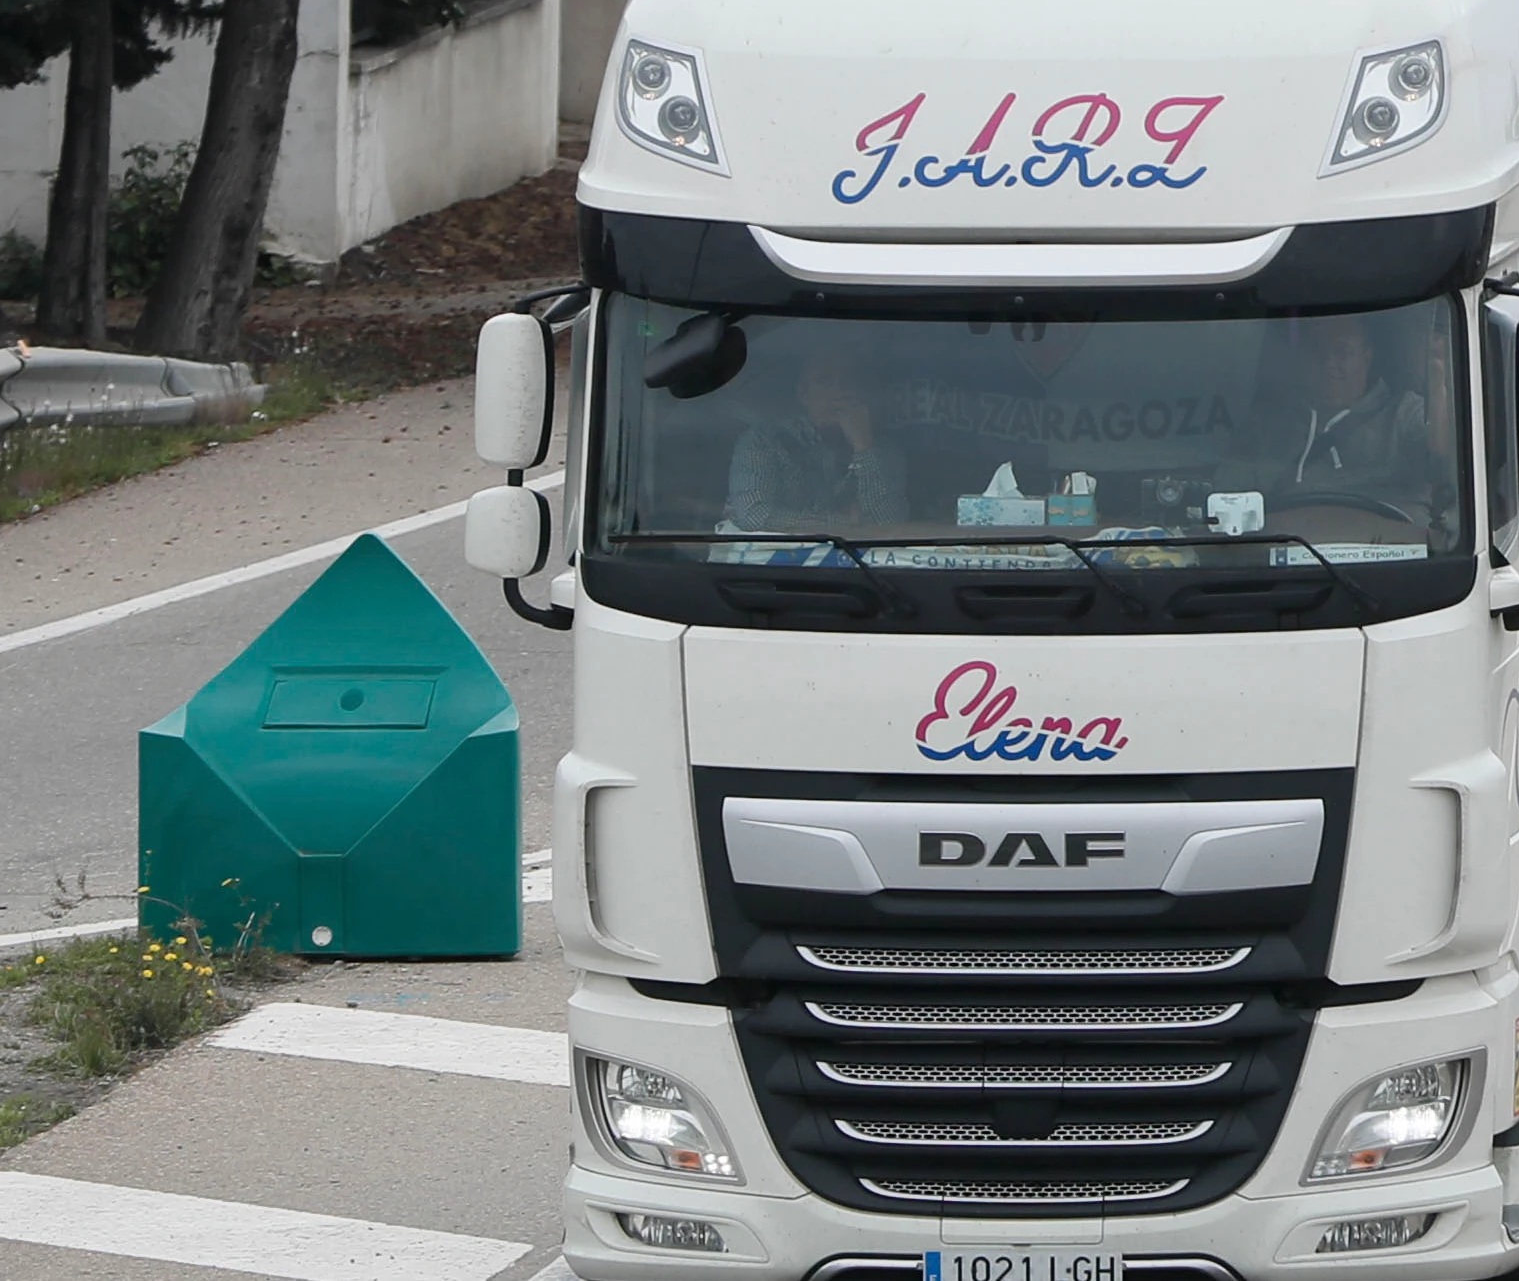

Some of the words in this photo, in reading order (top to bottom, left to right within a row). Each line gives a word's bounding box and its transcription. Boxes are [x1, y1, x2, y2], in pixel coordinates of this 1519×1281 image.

[978, 394, 1234, 444] ZARAGOZA
[1302, 551, 1359, 560] Caionero
[916, 660, 1129, 762] Elena
[918, 830, 1126, 868] DAF
[953, 1256, 1031, 1281] 1021
